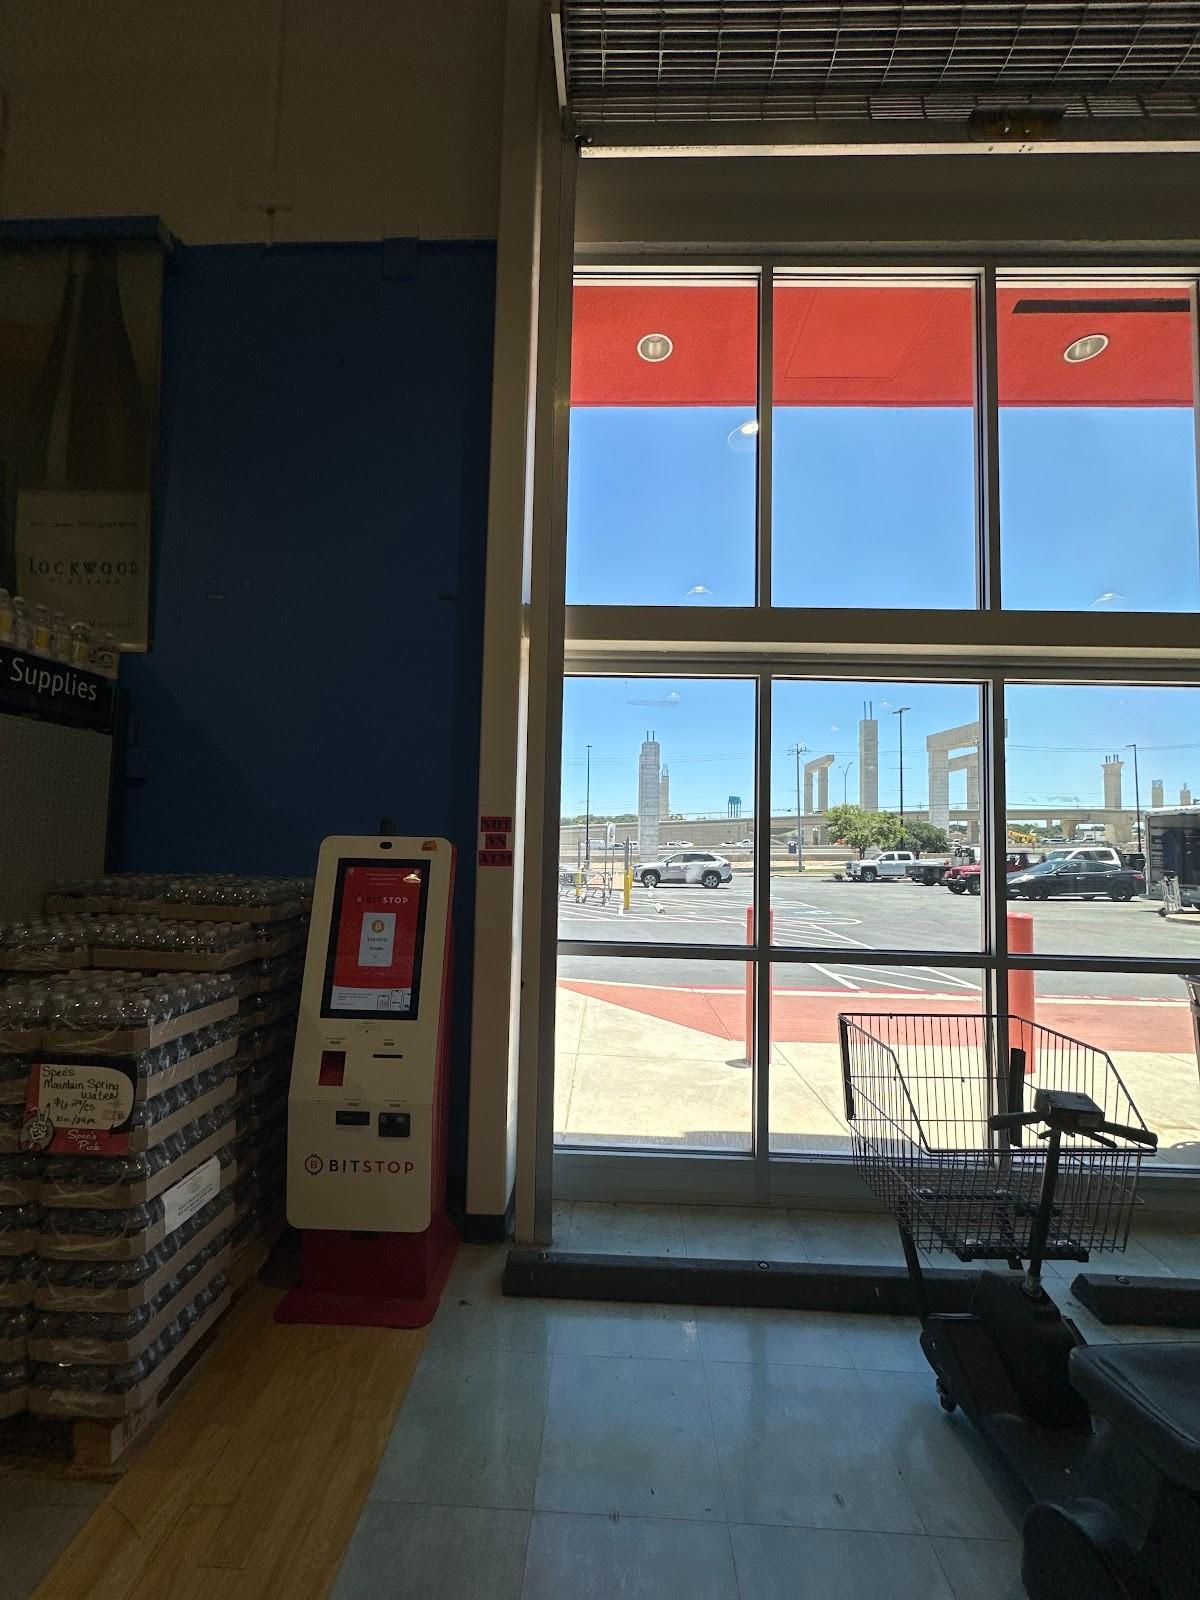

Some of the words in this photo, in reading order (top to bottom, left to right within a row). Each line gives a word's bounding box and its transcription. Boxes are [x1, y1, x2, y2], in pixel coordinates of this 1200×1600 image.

[30, 557, 138, 575] LOCKWOOD
[9, 657, 98, 702] Supplies
[43, 1079, 85, 1090] Mountain
[87, 1078, 119, 1097] Spring
[329, 1159, 414, 1174] BITSTOP
